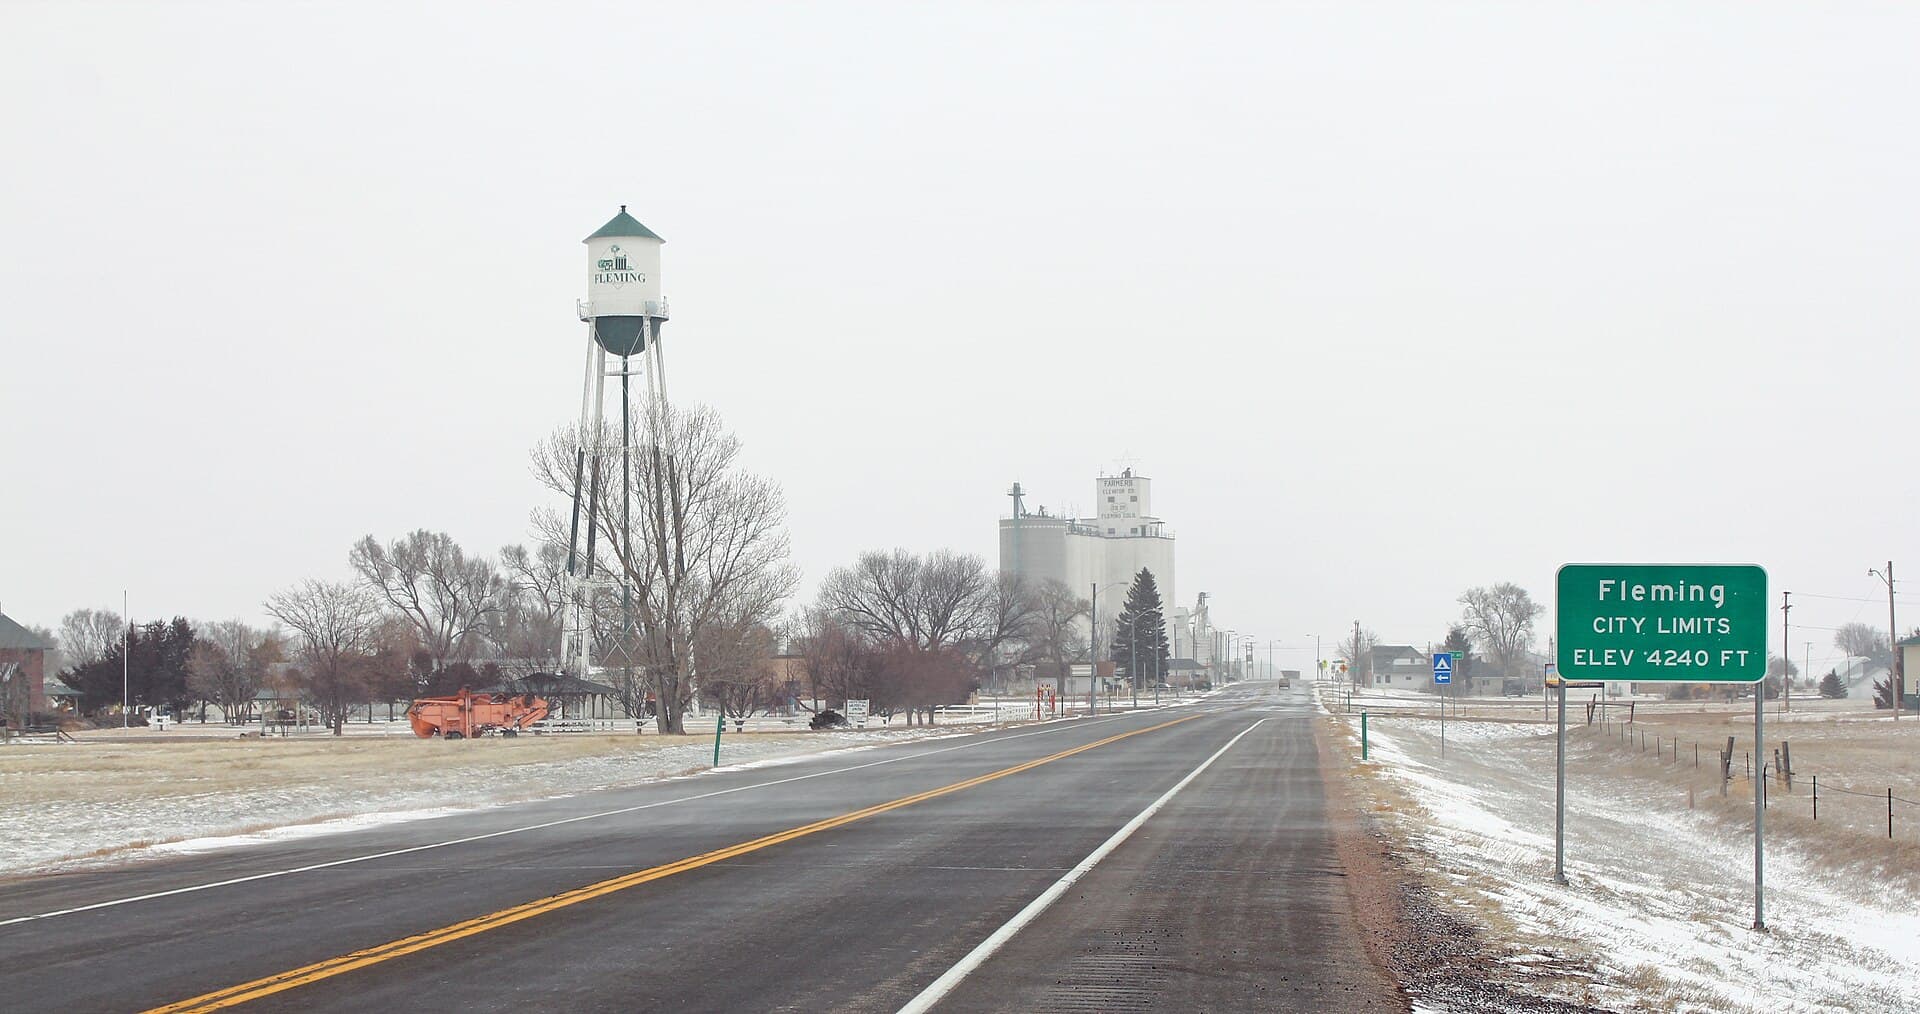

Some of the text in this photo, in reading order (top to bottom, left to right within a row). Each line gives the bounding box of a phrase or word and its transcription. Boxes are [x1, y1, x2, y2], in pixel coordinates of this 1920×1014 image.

[594, 272, 646, 284] FLEMING
[1599, 579, 1726, 609] Fleming
[1592, 617, 1731, 634] CITY LIMITS
[1573, 649, 1750, 667] ELEV 4240 FT
